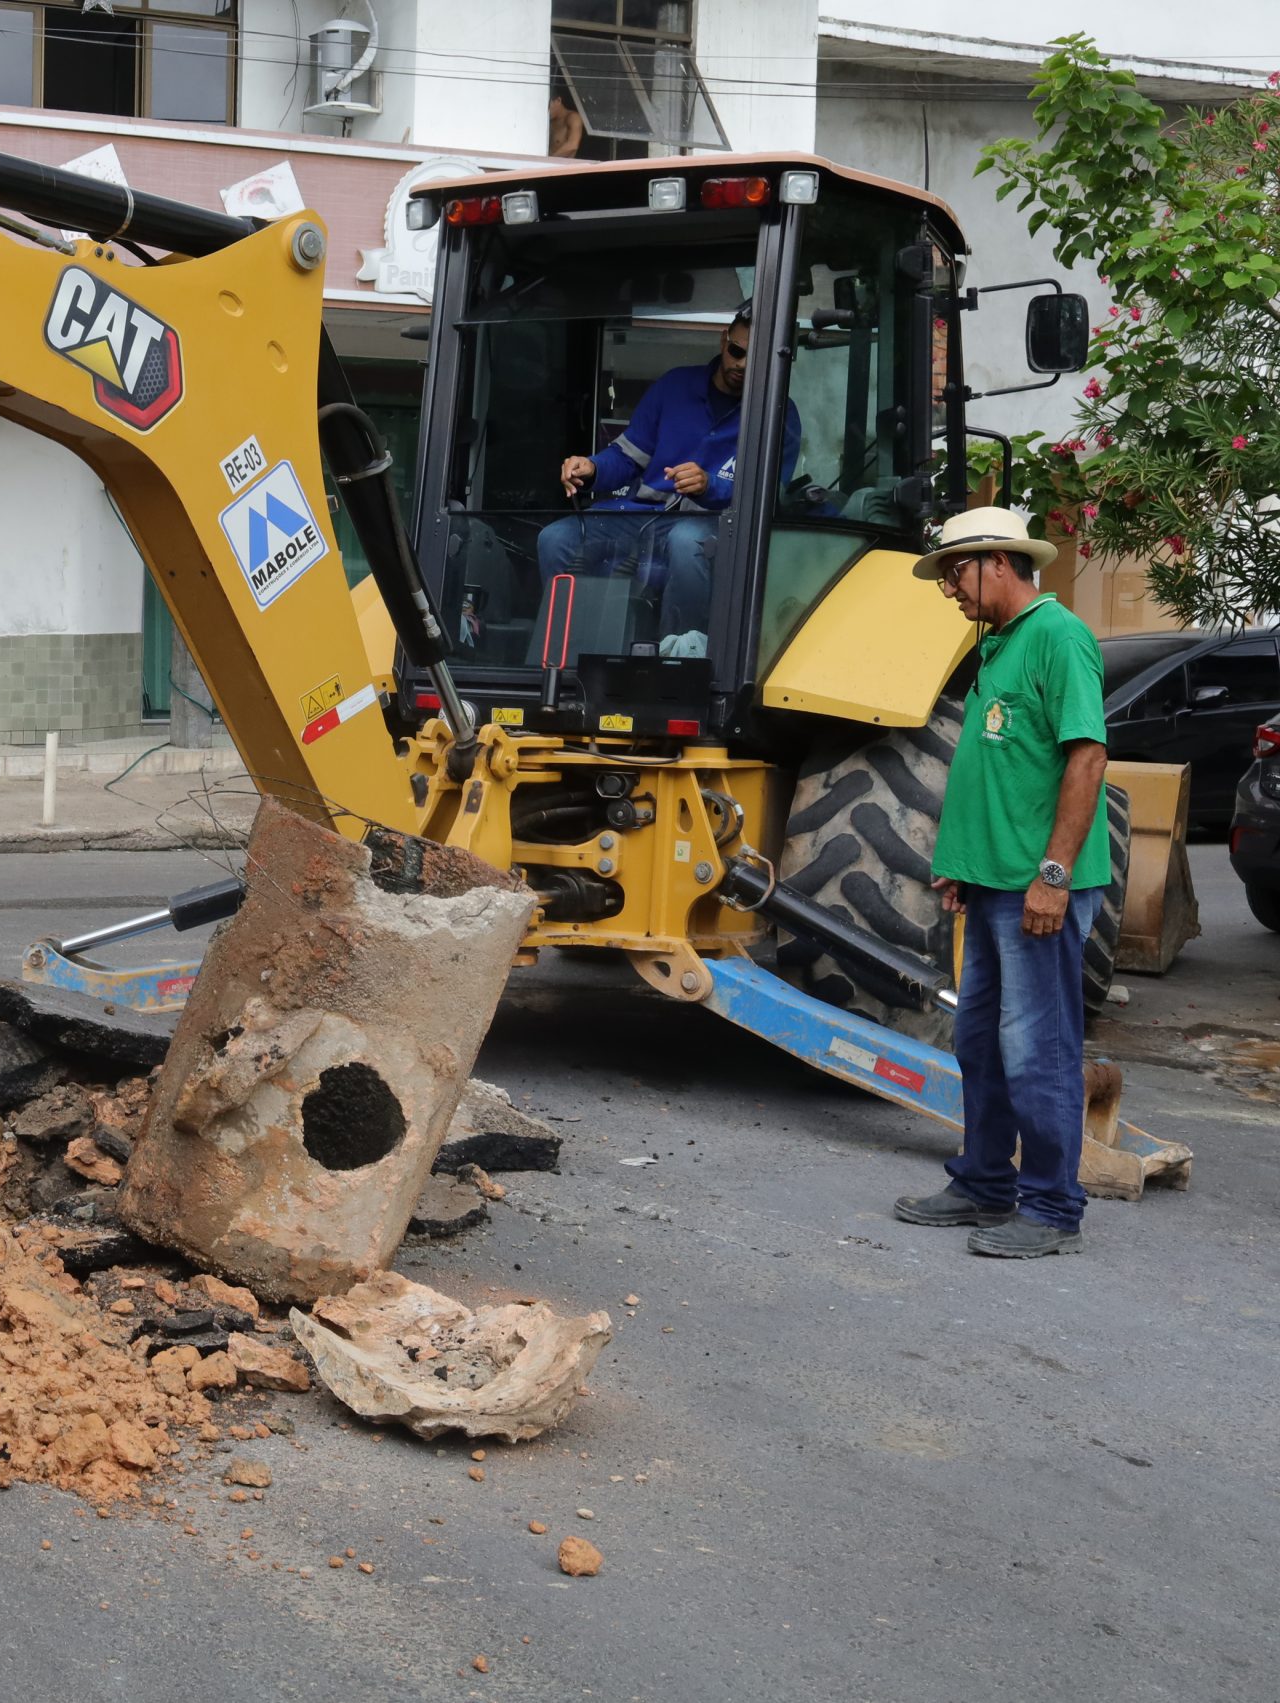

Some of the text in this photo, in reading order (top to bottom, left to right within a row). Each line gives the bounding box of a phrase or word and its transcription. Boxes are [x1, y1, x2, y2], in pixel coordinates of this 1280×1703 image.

[47, 267, 165, 395] CAT
[224, 442, 263, 488] RE-03
[251, 524, 317, 590] MABOLE
